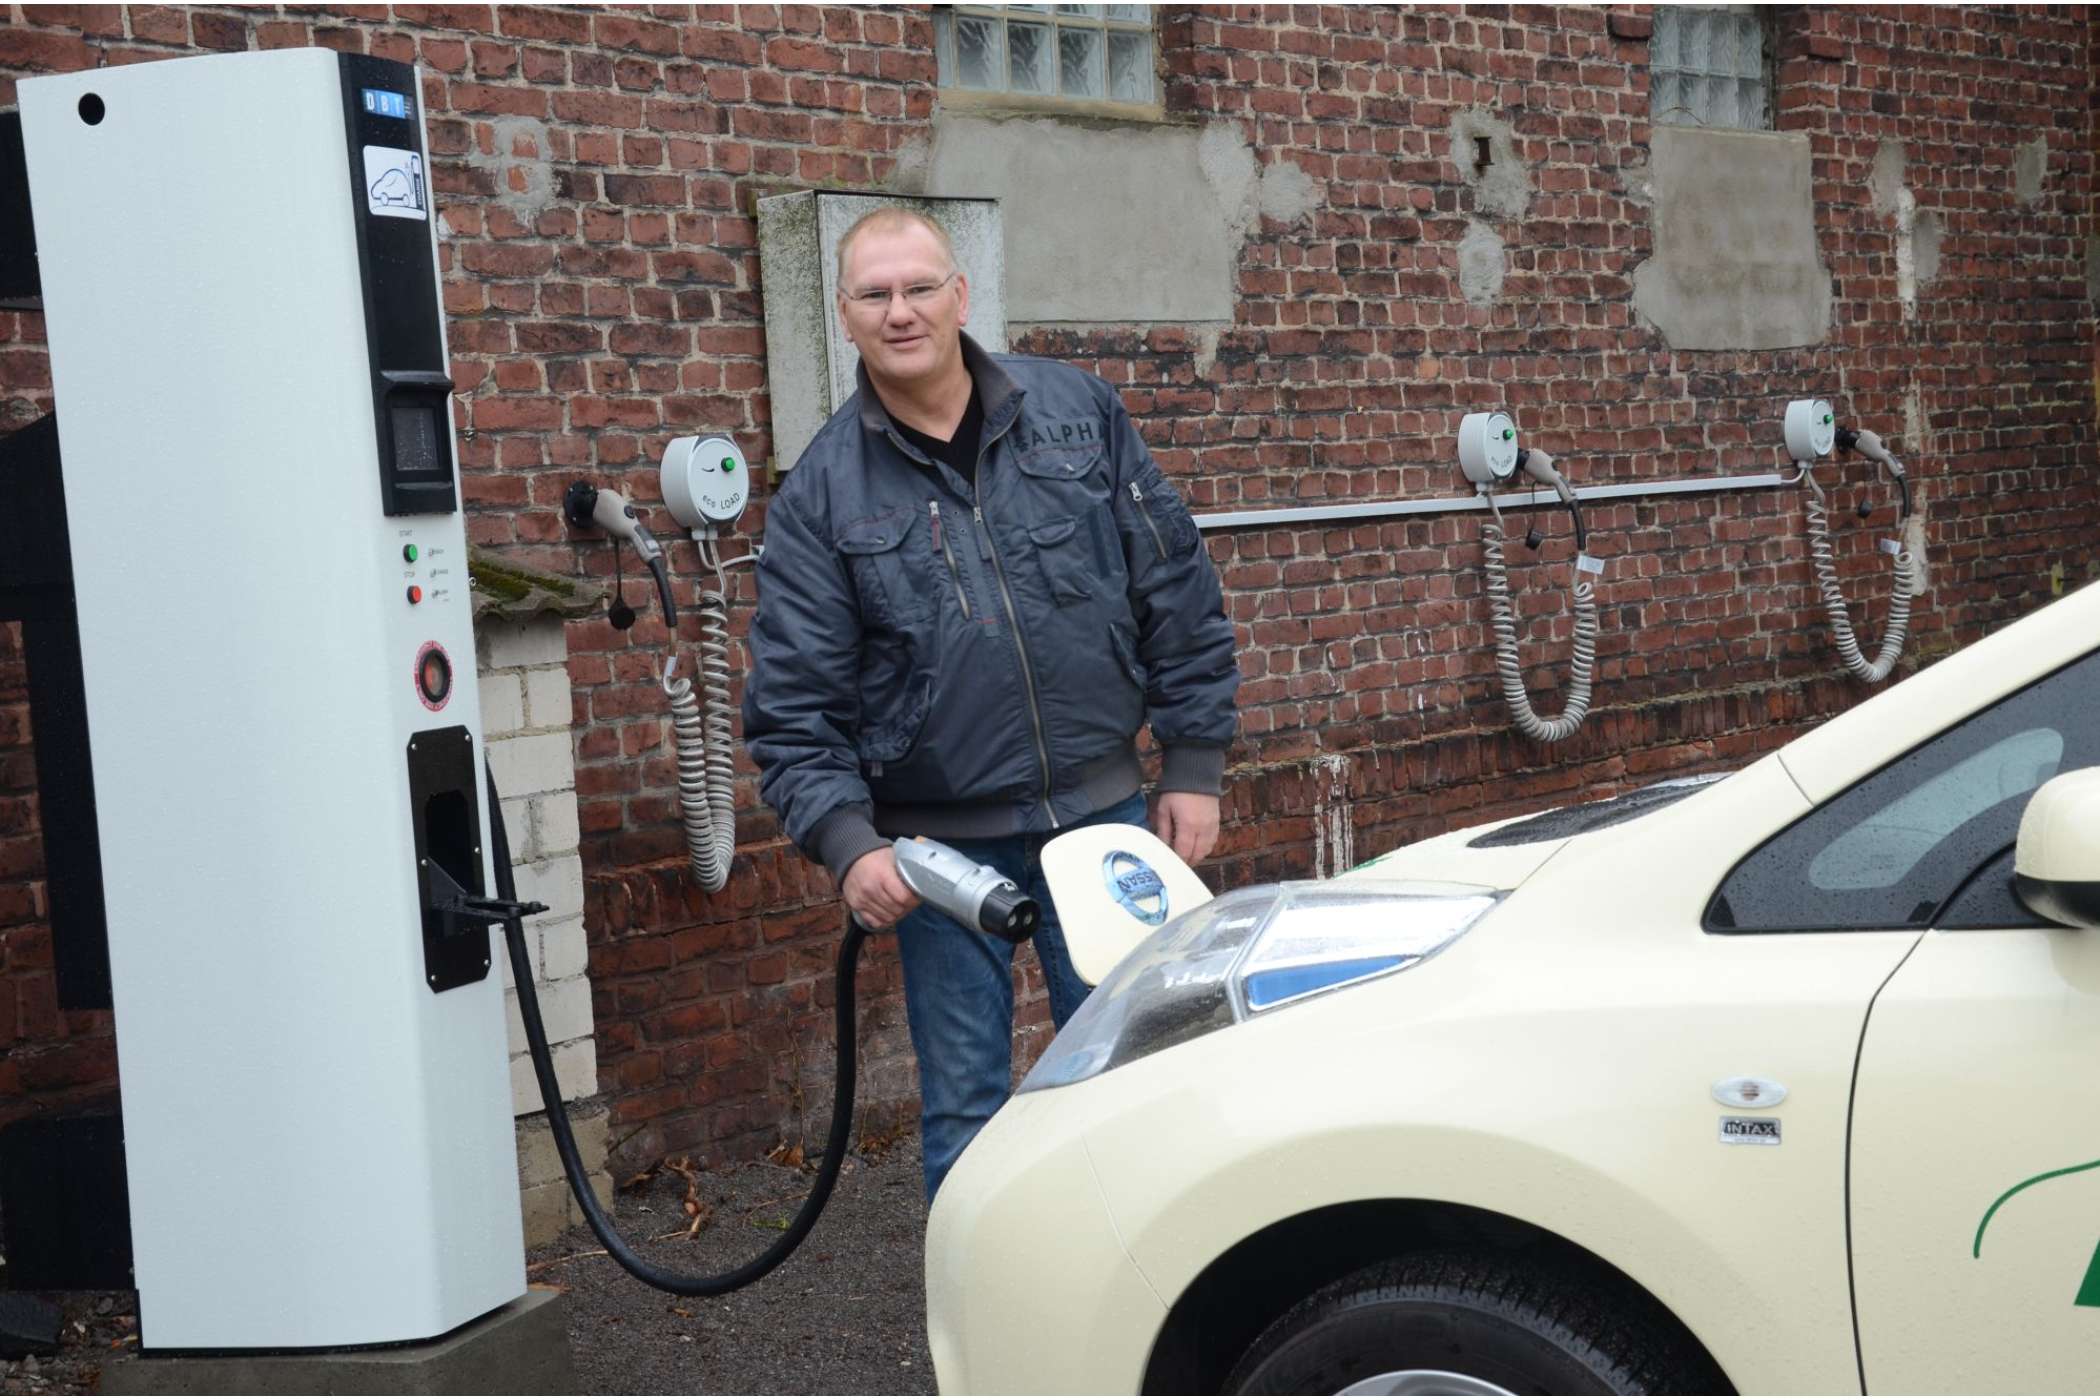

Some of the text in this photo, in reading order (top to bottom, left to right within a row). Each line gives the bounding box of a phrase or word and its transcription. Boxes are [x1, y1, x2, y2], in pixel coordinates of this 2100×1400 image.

[366, 92, 401, 115] DBT
[720, 492, 741, 510] LOAD
[1727, 1122, 1775, 1135] INTAX
